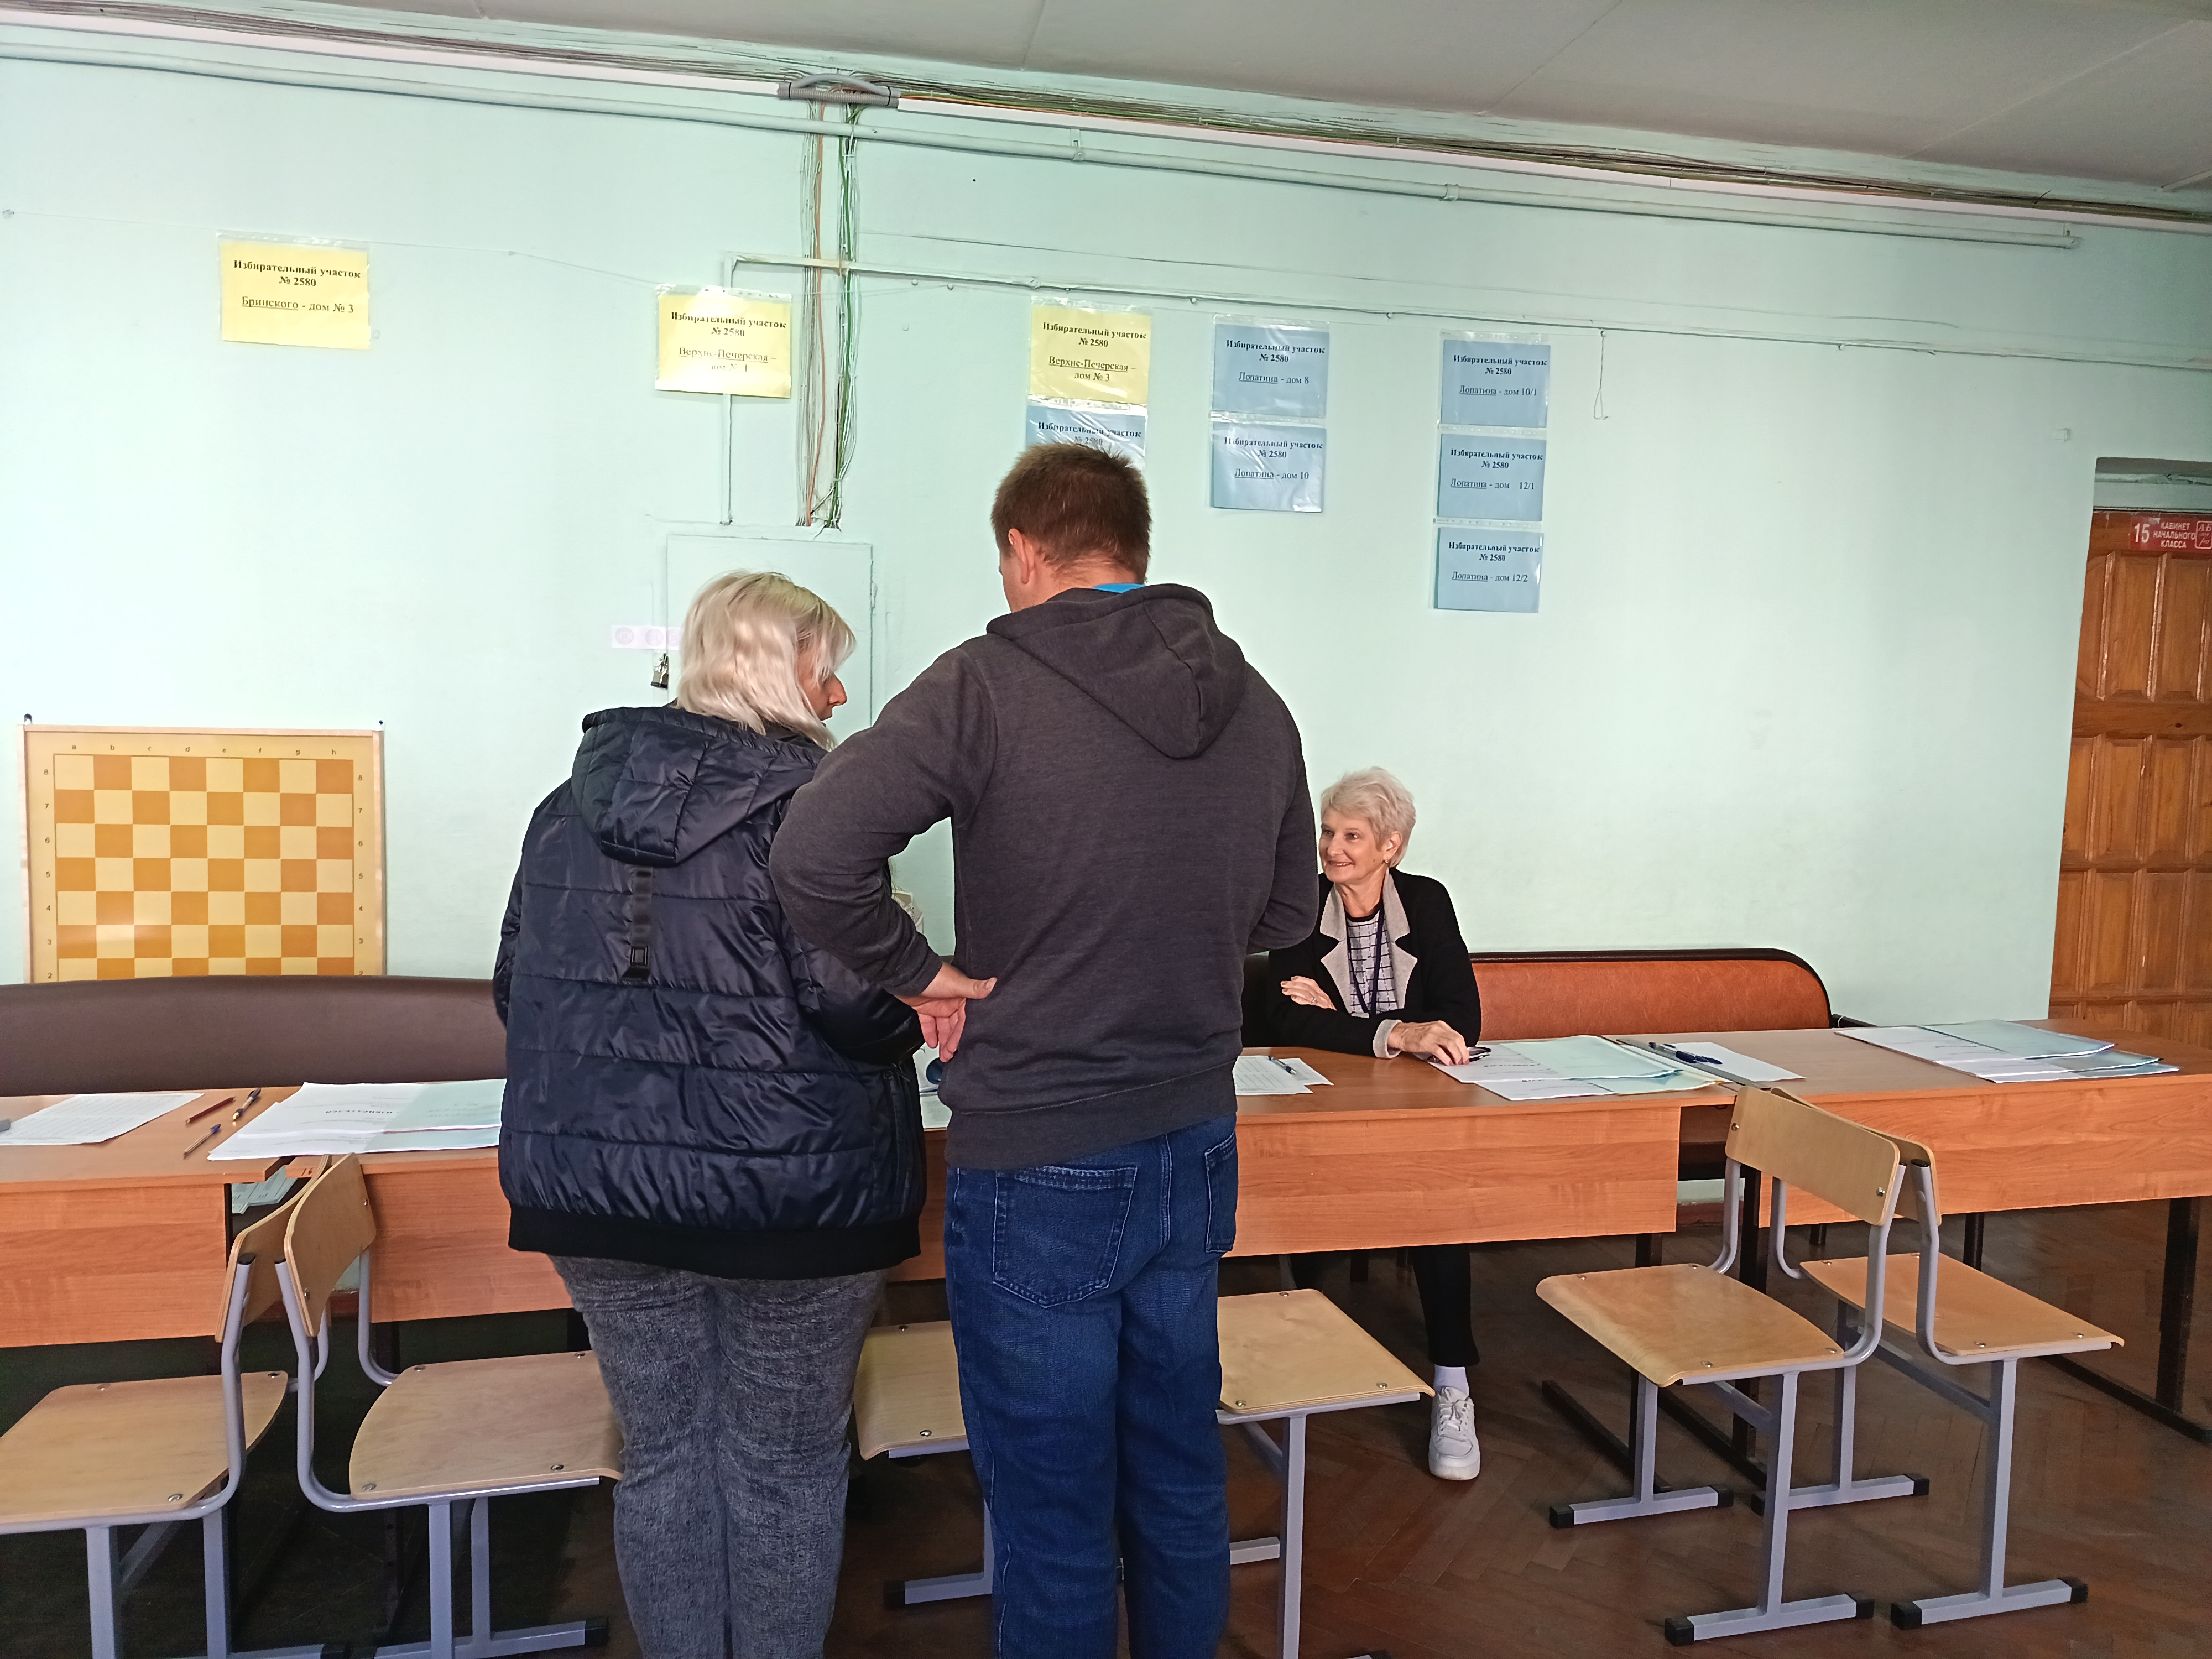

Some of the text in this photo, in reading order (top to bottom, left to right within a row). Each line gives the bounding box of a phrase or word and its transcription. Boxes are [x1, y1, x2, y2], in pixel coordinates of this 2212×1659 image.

[234, 260, 361, 278] Избирательный участок
[294, 277, 316, 286] 2580
[242, 296, 299, 310] Бринского
[309, 303, 329, 311] дом
[333, 304, 345, 312] №
[348, 304, 353, 313] 3
[671, 312, 786, 328] Избирательный участок
[724, 327, 745, 336] 2580
[1044, 322, 1147, 339] Избирательный участок
[1078, 337, 1108, 347] № 2580
[1227, 340, 1326, 354] Избирательный участок
[679, 347, 768, 362] Верхне-Печерская
[1271, 354, 1289, 363] 2580
[1454, 354, 1512, 365] Избирательный
[1049, 356, 1128, 371] Верхне-Печерская
[1074, 372, 1110, 382] дом № 3
[1239, 372, 1278, 383] Лопатина
[1305, 376, 1309, 384] 8
[1459, 385, 1496, 396] Лопатина
[1522, 388, 1537, 396] 10/1
[1224, 437, 1323, 450] Избирательный участок
[1269, 450, 1287, 458] 2580
[1451, 448, 1510, 458] Избирательный
[1492, 461, 1509, 469] 2580
[1234, 468, 1274, 479] Лопатина
[1281, 472, 1297, 480] дом
[1301, 471, 1309, 480] 10
[1451, 478, 1487, 489] Лопатина
[1520, 482, 1534, 490] 12/1
[2161, 522, 2190, 530] КАБИНЕТ
[2135, 523, 2150, 543] 15
[2153, 531, 2196, 540] НАЧАЛЬНОГО
[1449, 542, 1506, 552] Избирательный
[2161, 540, 2187, 549] КЛАССА
[1452, 571, 1488, 582] Лопатина
[1512, 574, 1528, 582] 12/2
